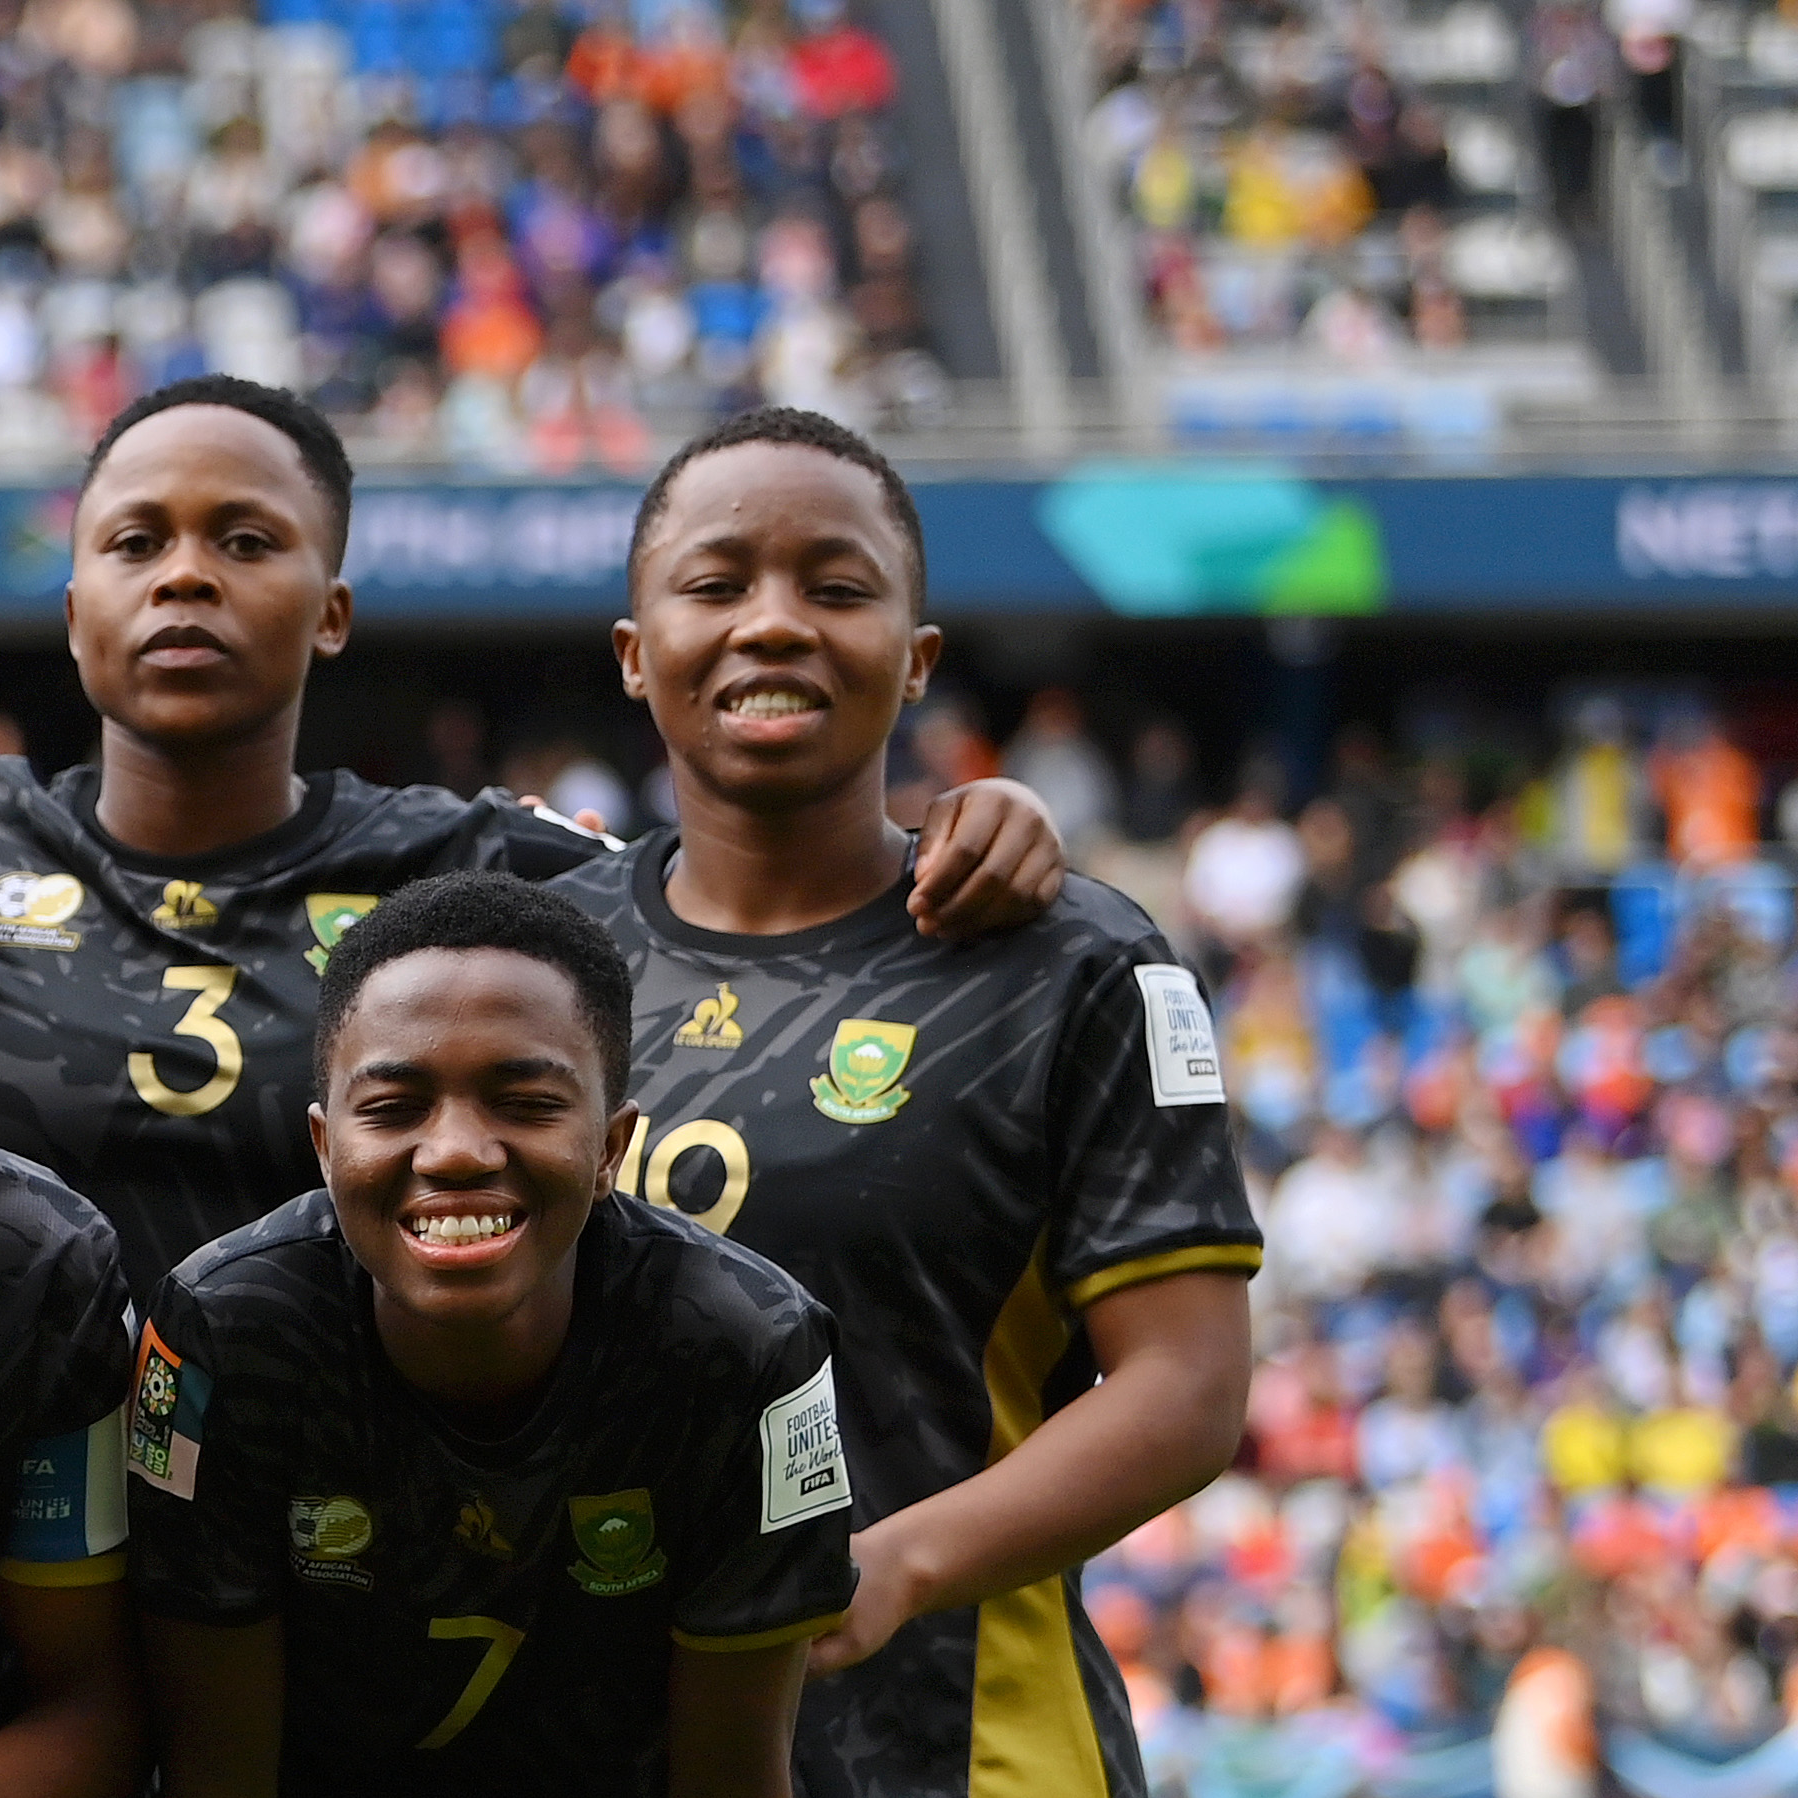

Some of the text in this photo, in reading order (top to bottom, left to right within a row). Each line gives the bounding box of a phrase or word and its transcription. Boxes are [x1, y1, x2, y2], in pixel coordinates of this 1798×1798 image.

[127, 965, 243, 1116] 3
[787, 1397, 832, 1435] FOOTBAL
[808, 1438, 843, 1470] Worl
[804, 1473, 832, 1491] FIFA
[415, 1615, 525, 1750] 7
